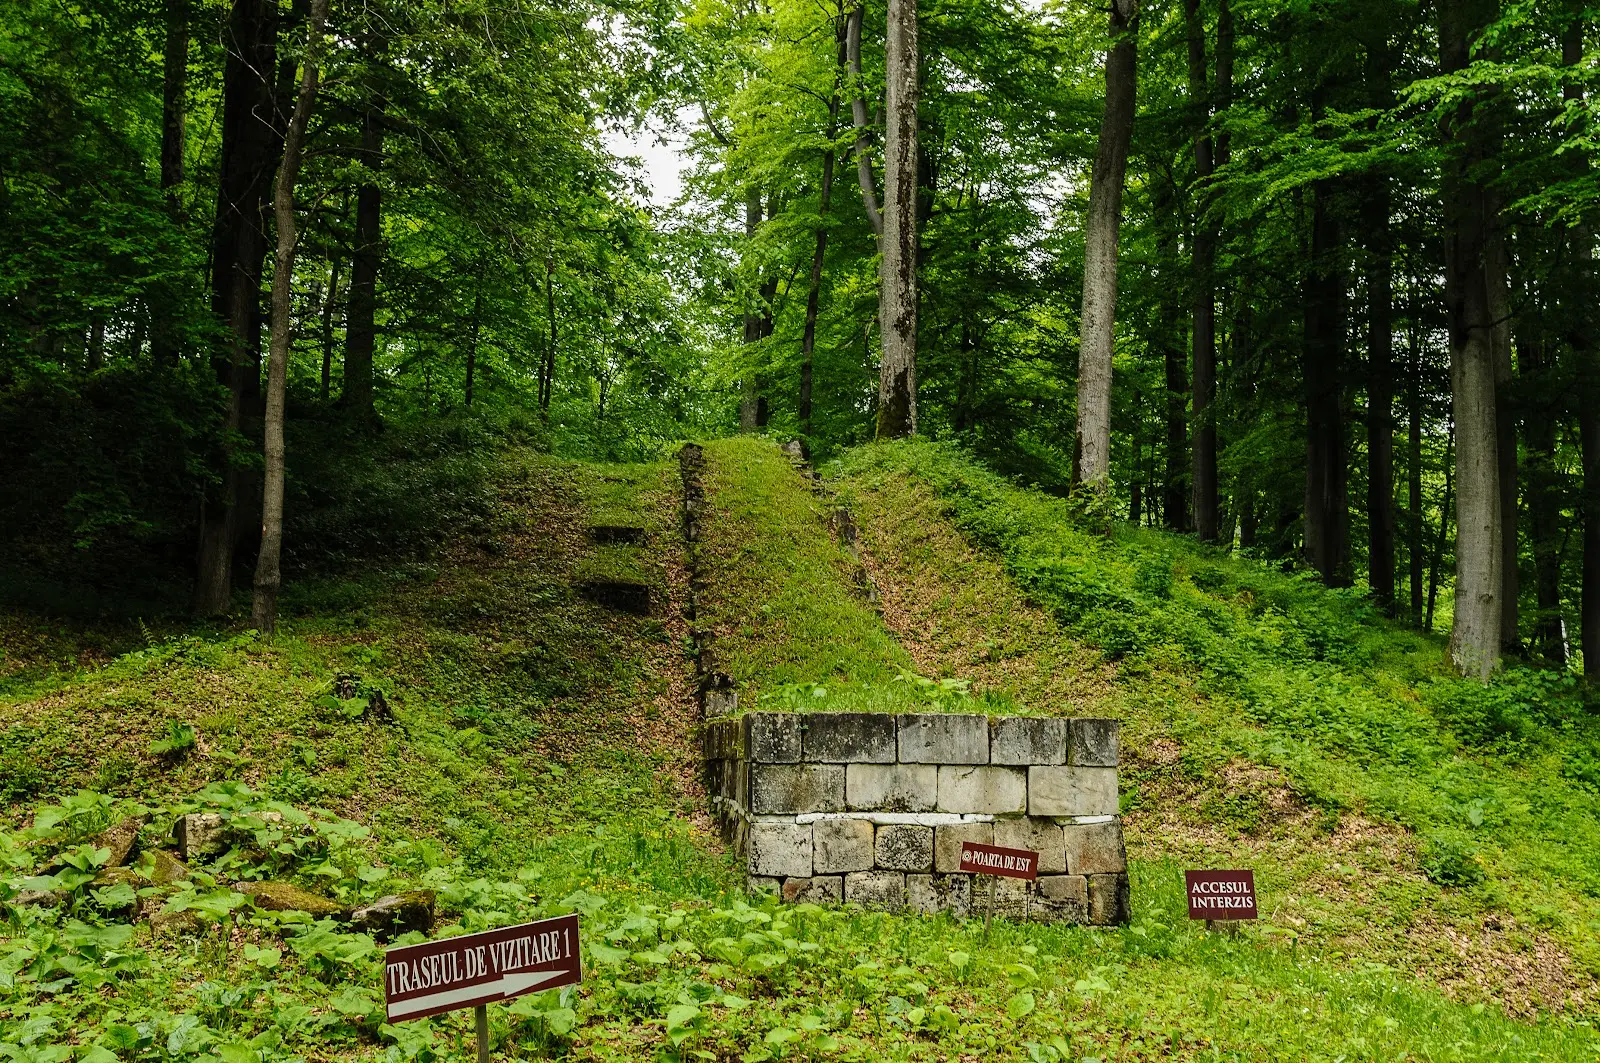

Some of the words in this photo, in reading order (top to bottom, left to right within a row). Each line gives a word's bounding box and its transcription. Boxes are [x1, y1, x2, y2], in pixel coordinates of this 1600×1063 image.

[972, 850, 1003, 868] POARTA
[1004, 855, 1015, 870] DE
[1015, 857, 1031, 872] EST
[1192, 882, 1250, 893] ACCESUL
[1192, 896, 1253, 908] INTERZIS
[387, 951, 463, 995] TRASEUL
[464, 945, 487, 980] DE
[489, 930, 560, 973] VIZITARE
[563, 928, 571, 958] 1
